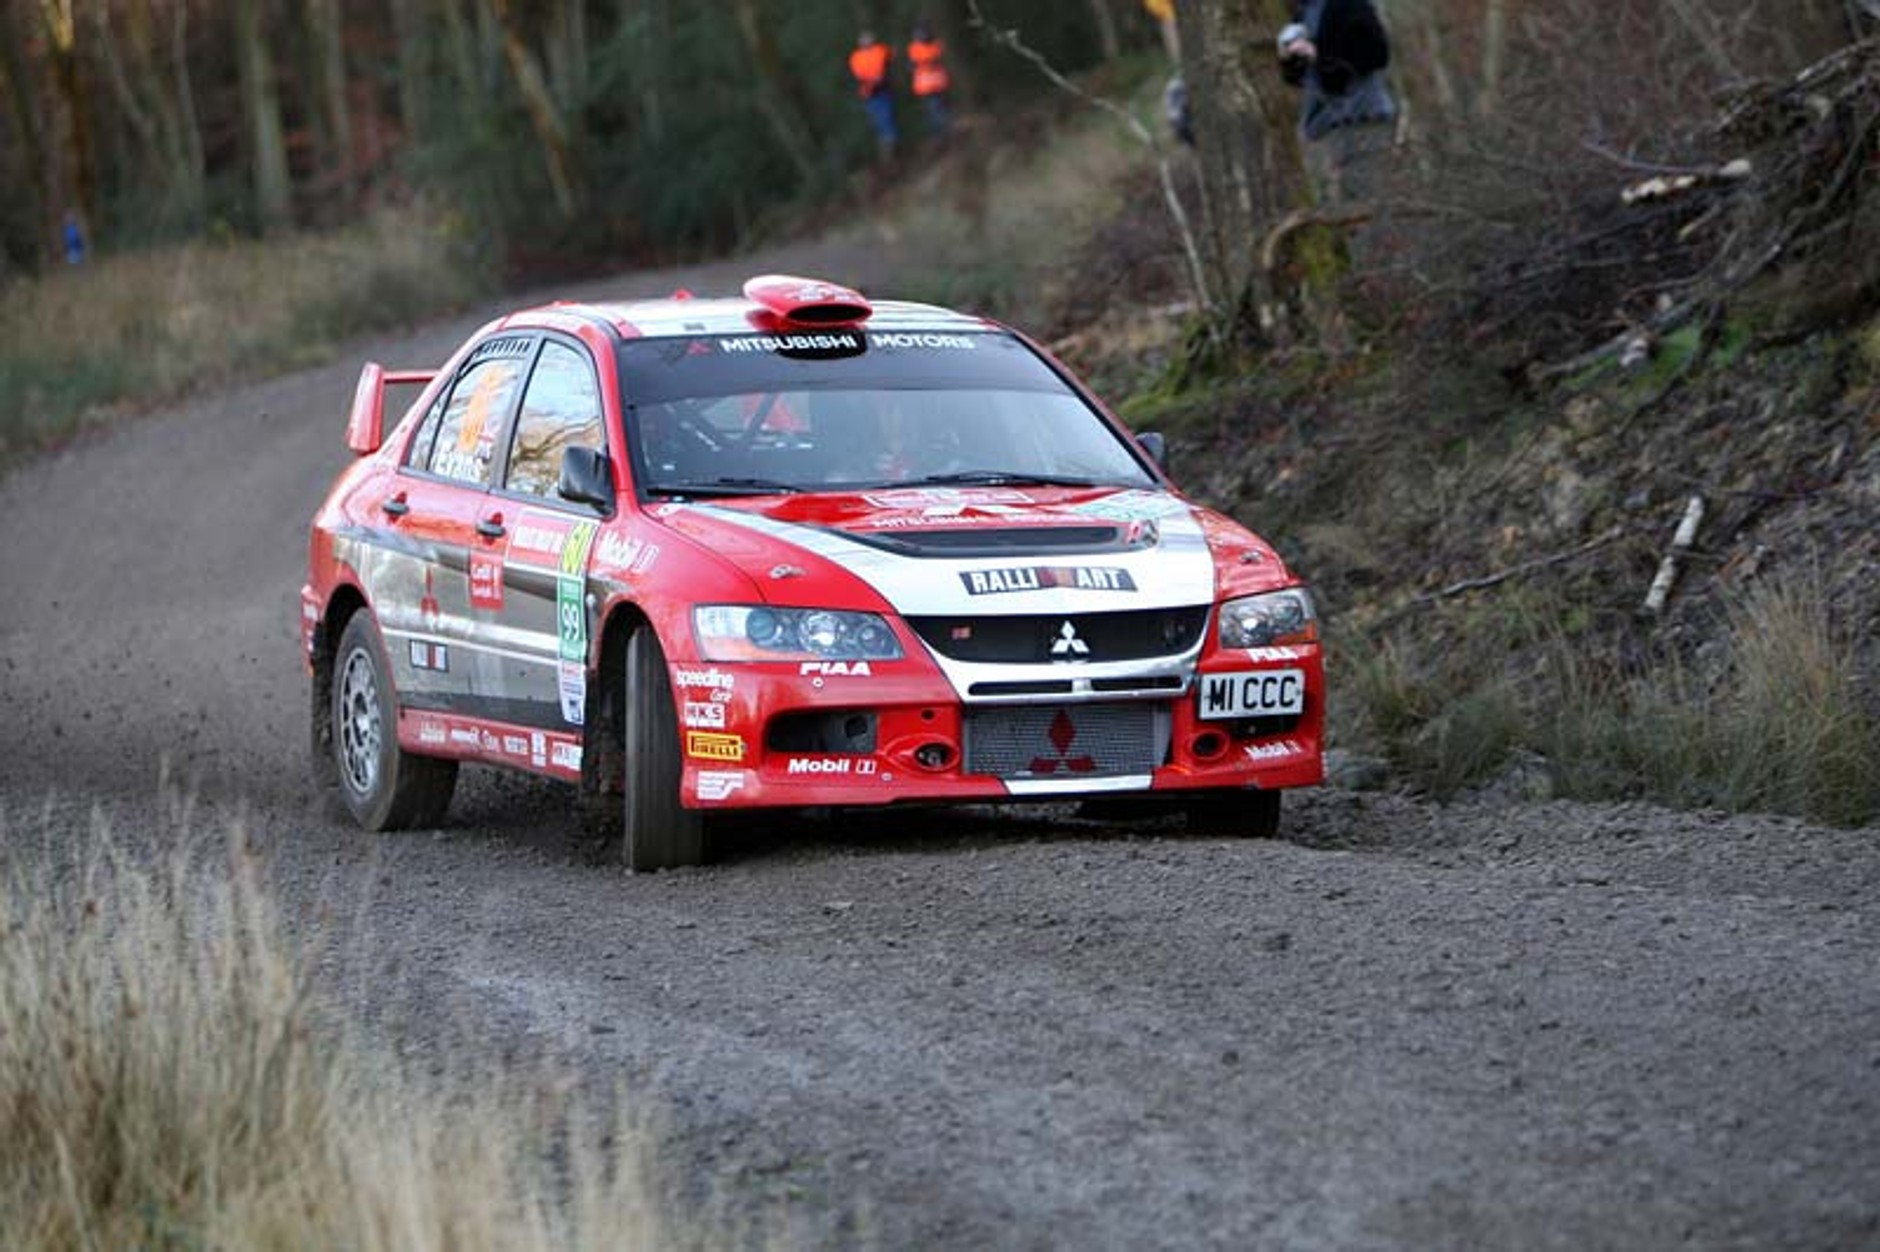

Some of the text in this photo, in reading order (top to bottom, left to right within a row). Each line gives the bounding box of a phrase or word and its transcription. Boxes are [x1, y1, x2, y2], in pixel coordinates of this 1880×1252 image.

[720, 333, 976, 353] MITSUBISHI MOTORS
[800, 661, 871, 676] PIAA
[1243, 676, 1296, 709] CCC
[691, 735, 739, 756] PIRELLI
[789, 758, 850, 774] Mobil
